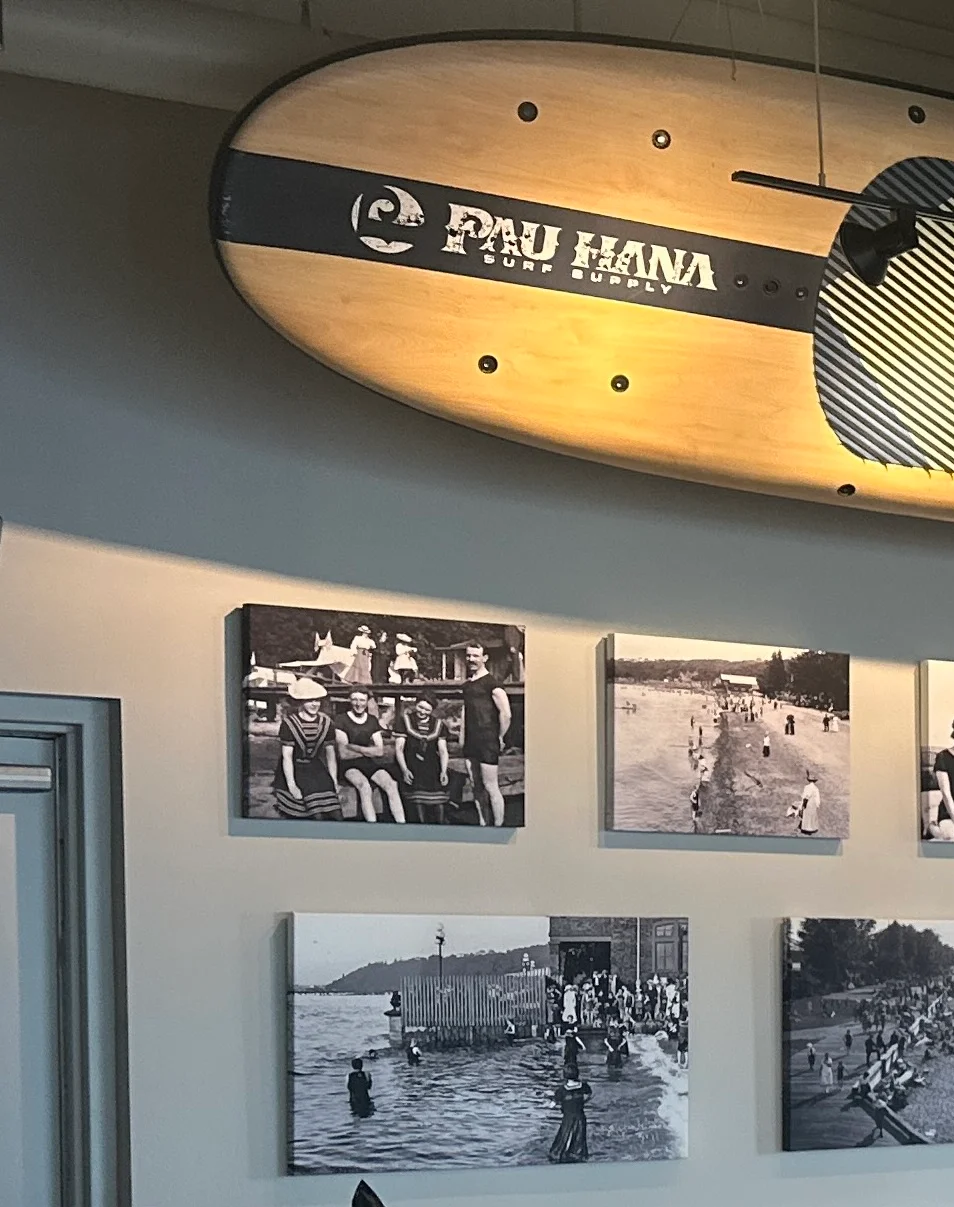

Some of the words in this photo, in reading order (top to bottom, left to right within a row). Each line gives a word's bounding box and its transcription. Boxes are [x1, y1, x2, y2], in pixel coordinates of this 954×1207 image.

[441, 203, 563, 263] PAU
[571, 230, 719, 292] HANA
[483, 254, 554, 275] SURF
[572, 268, 673, 295] SUPPLY
